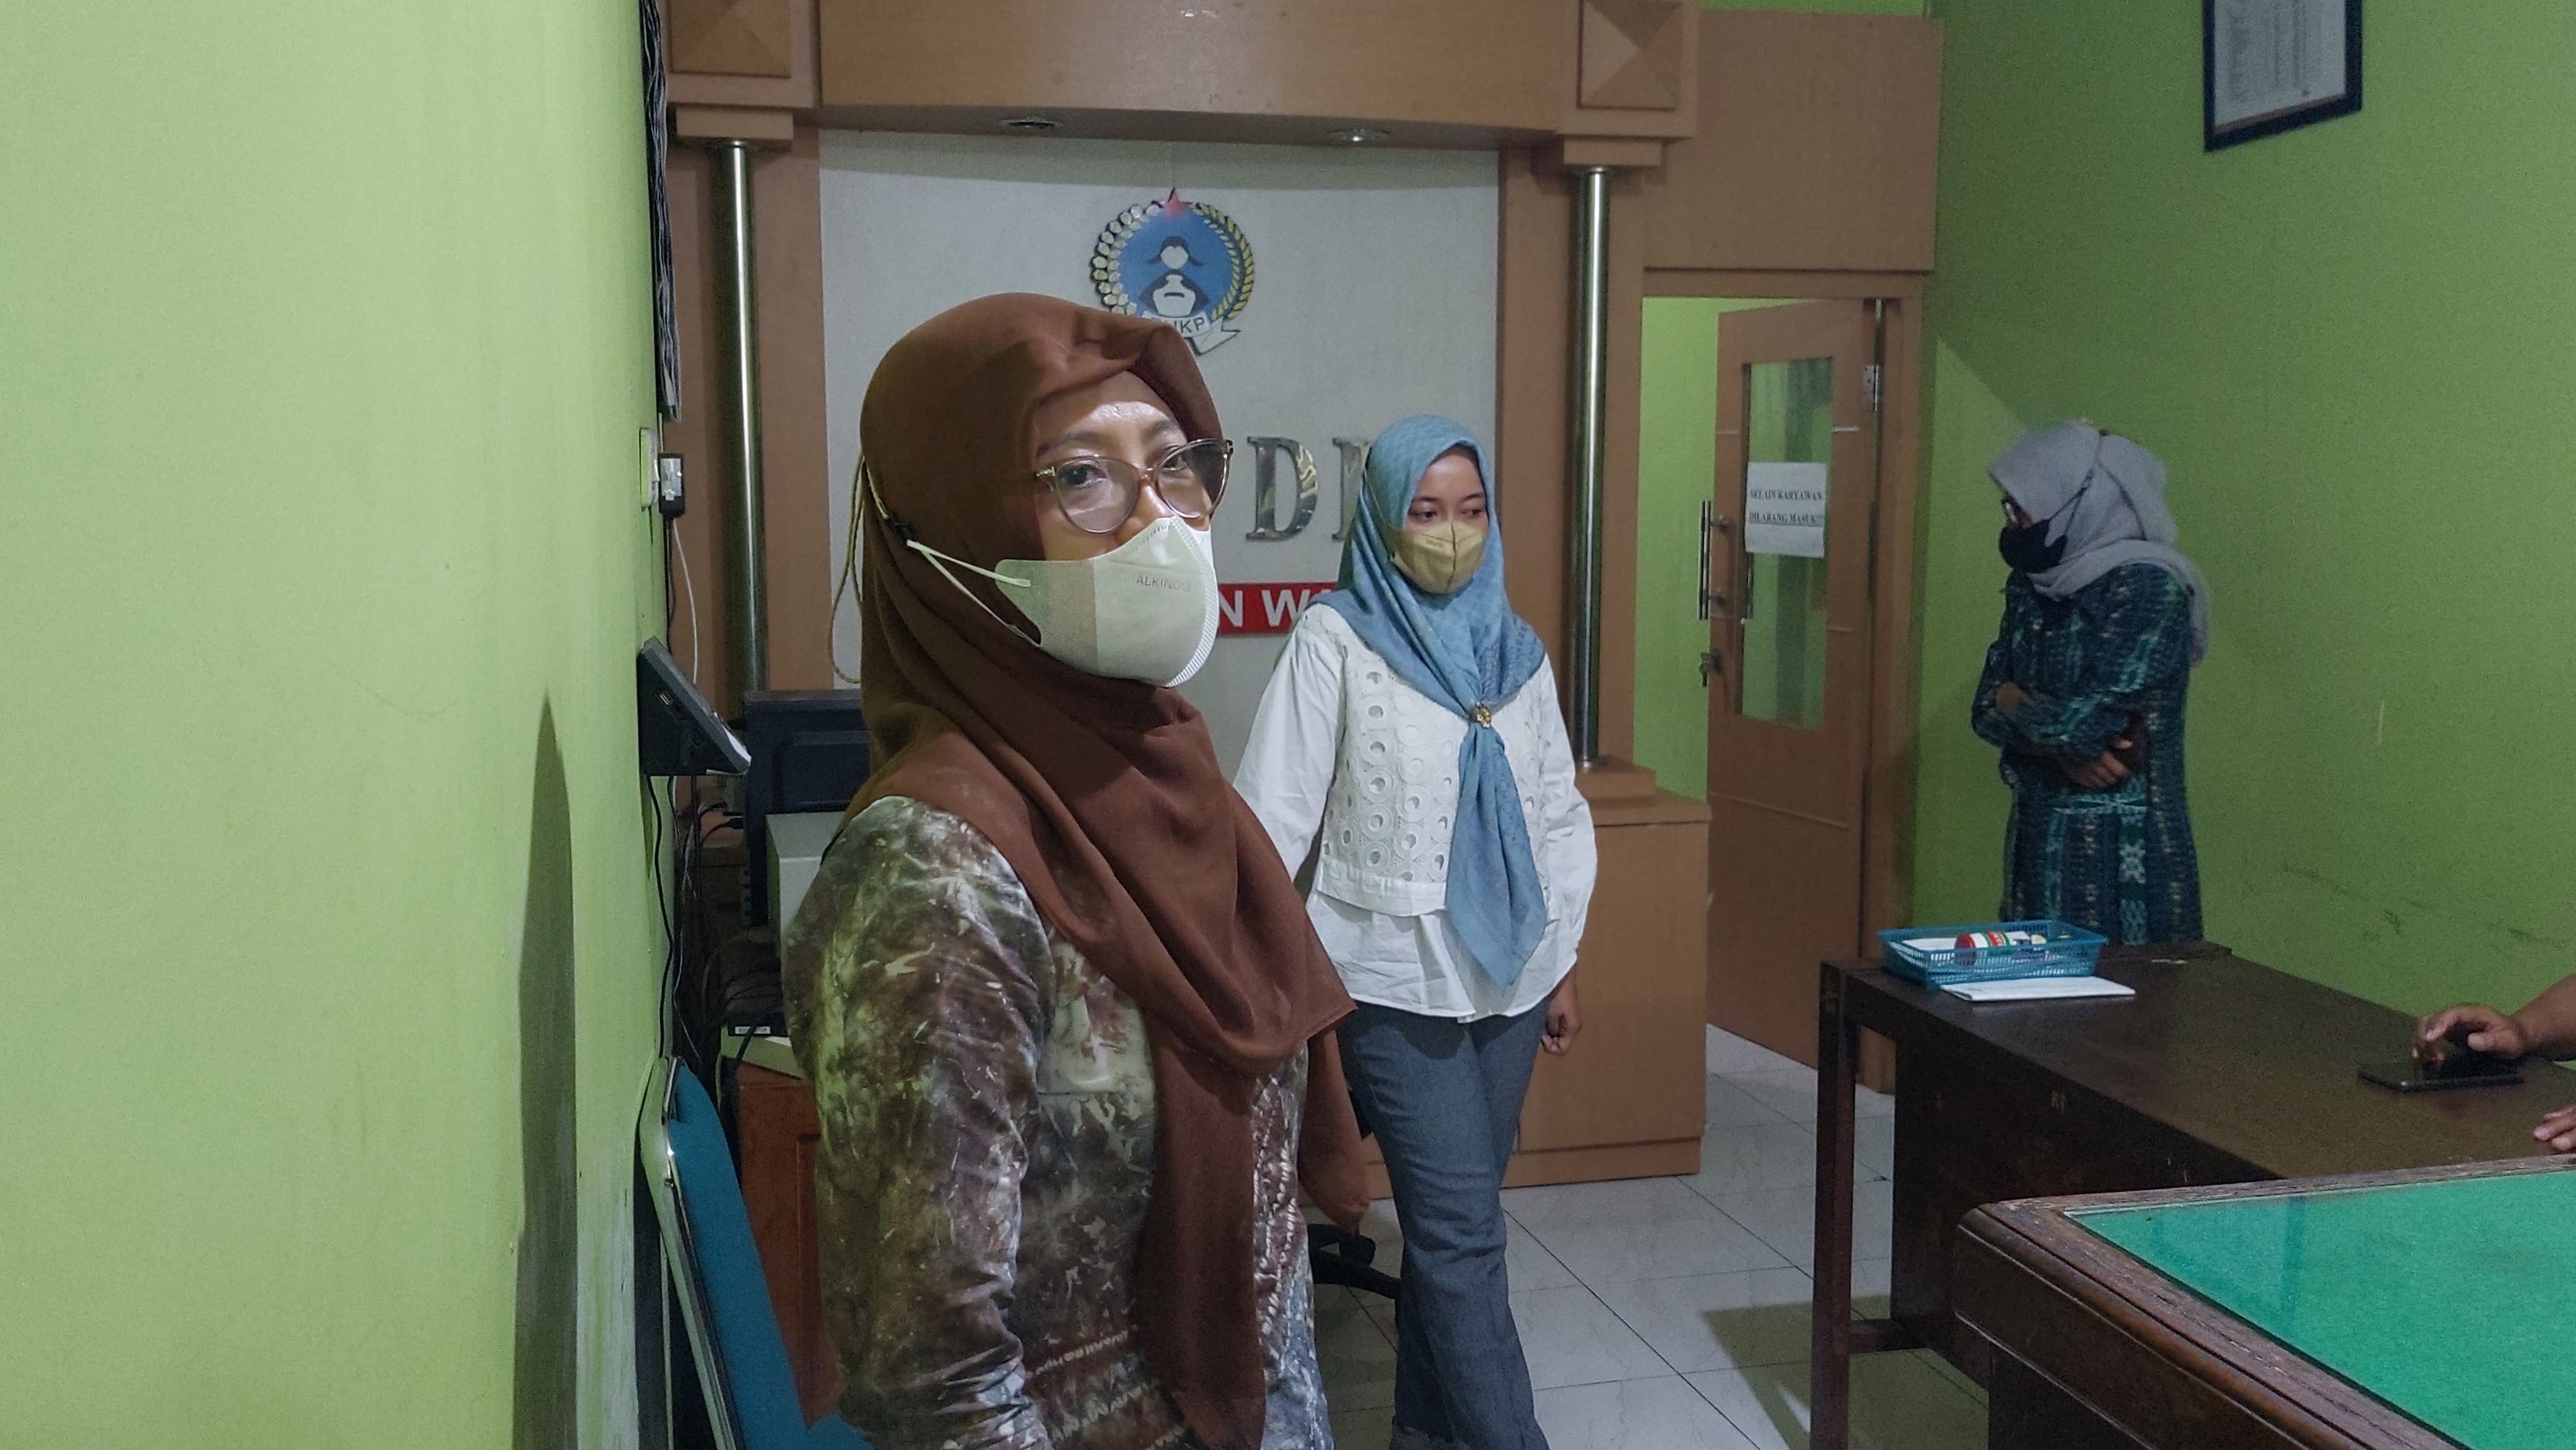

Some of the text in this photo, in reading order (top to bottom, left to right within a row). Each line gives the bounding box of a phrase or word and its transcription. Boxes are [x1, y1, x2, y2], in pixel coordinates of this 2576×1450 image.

[1749, 489, 1822, 501] SELAIN KARYAWAN
[1749, 512, 1787, 523] DILARANG
[1136, 575, 1191, 592] ALKINDO
